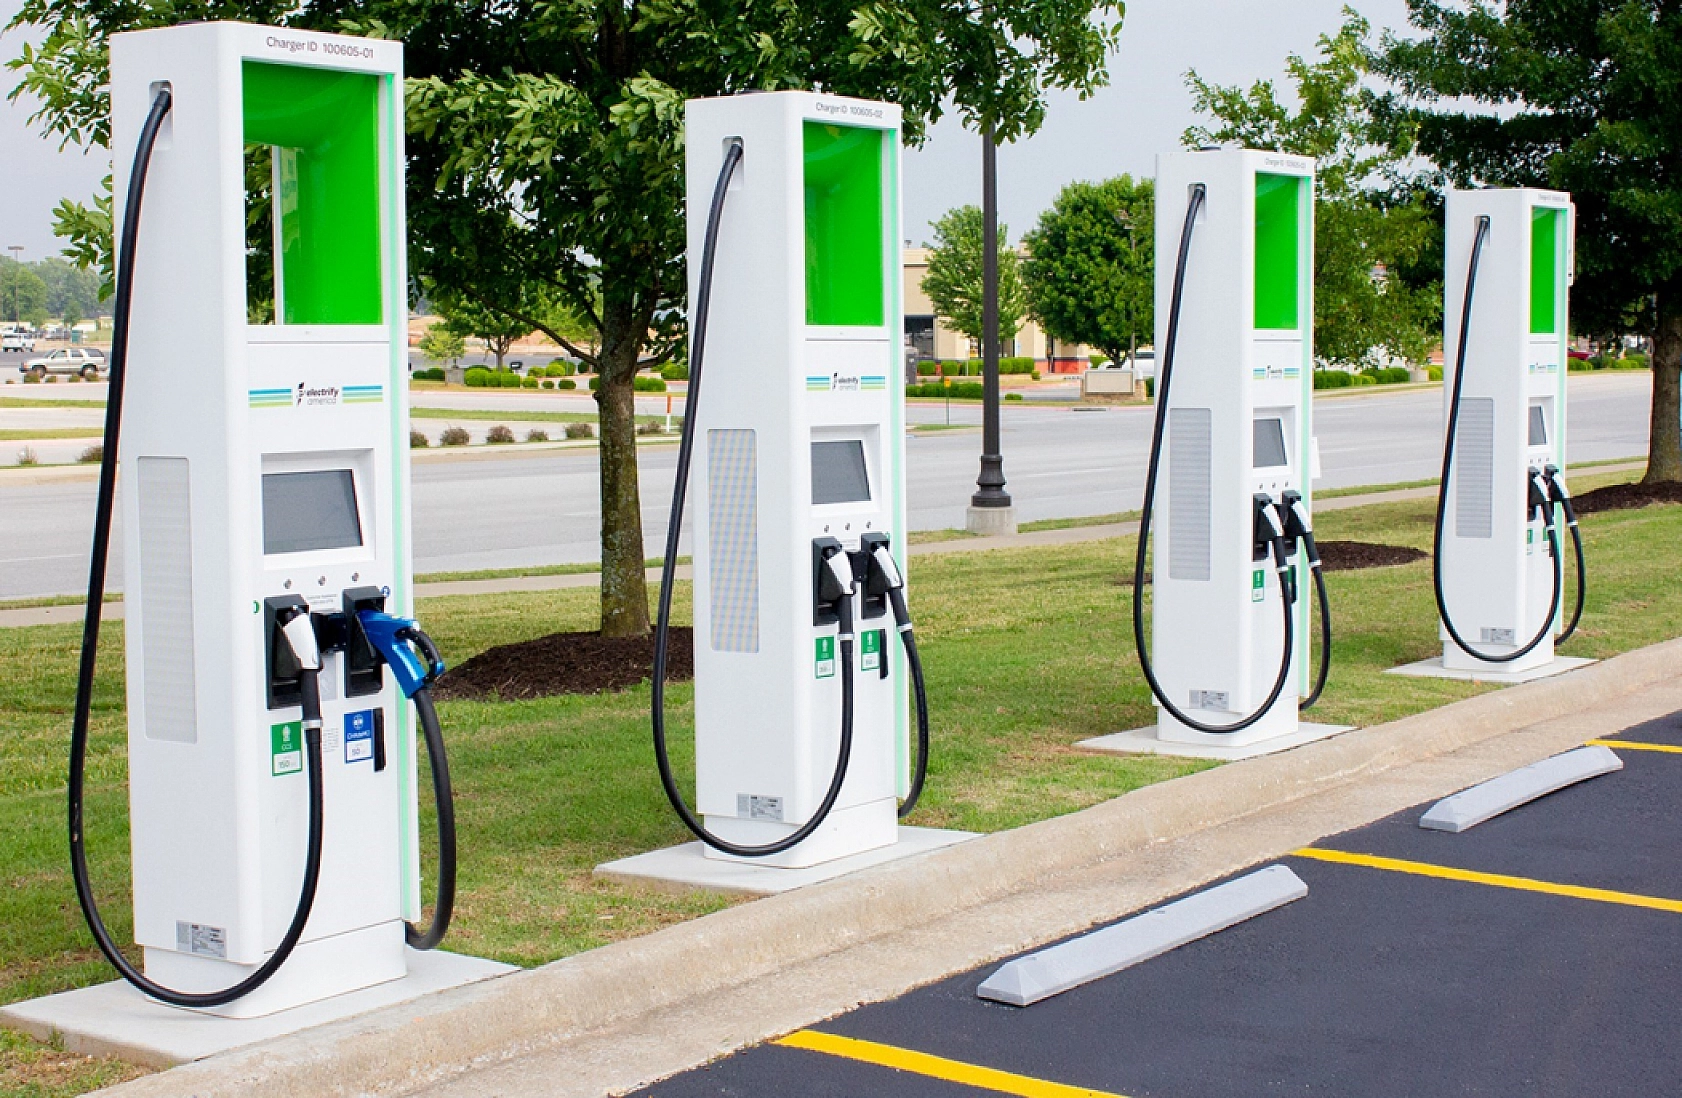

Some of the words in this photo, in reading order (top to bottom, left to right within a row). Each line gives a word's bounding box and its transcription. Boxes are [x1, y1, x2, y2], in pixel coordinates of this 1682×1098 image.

[266, 36, 306, 53] Charger
[307, 41, 317, 51] ID
[322, 42, 374, 58] 100605-01
[816, 102, 840, 115] Charger
[306, 387, 339, 397] electrify
[307, 397, 337, 406] america
